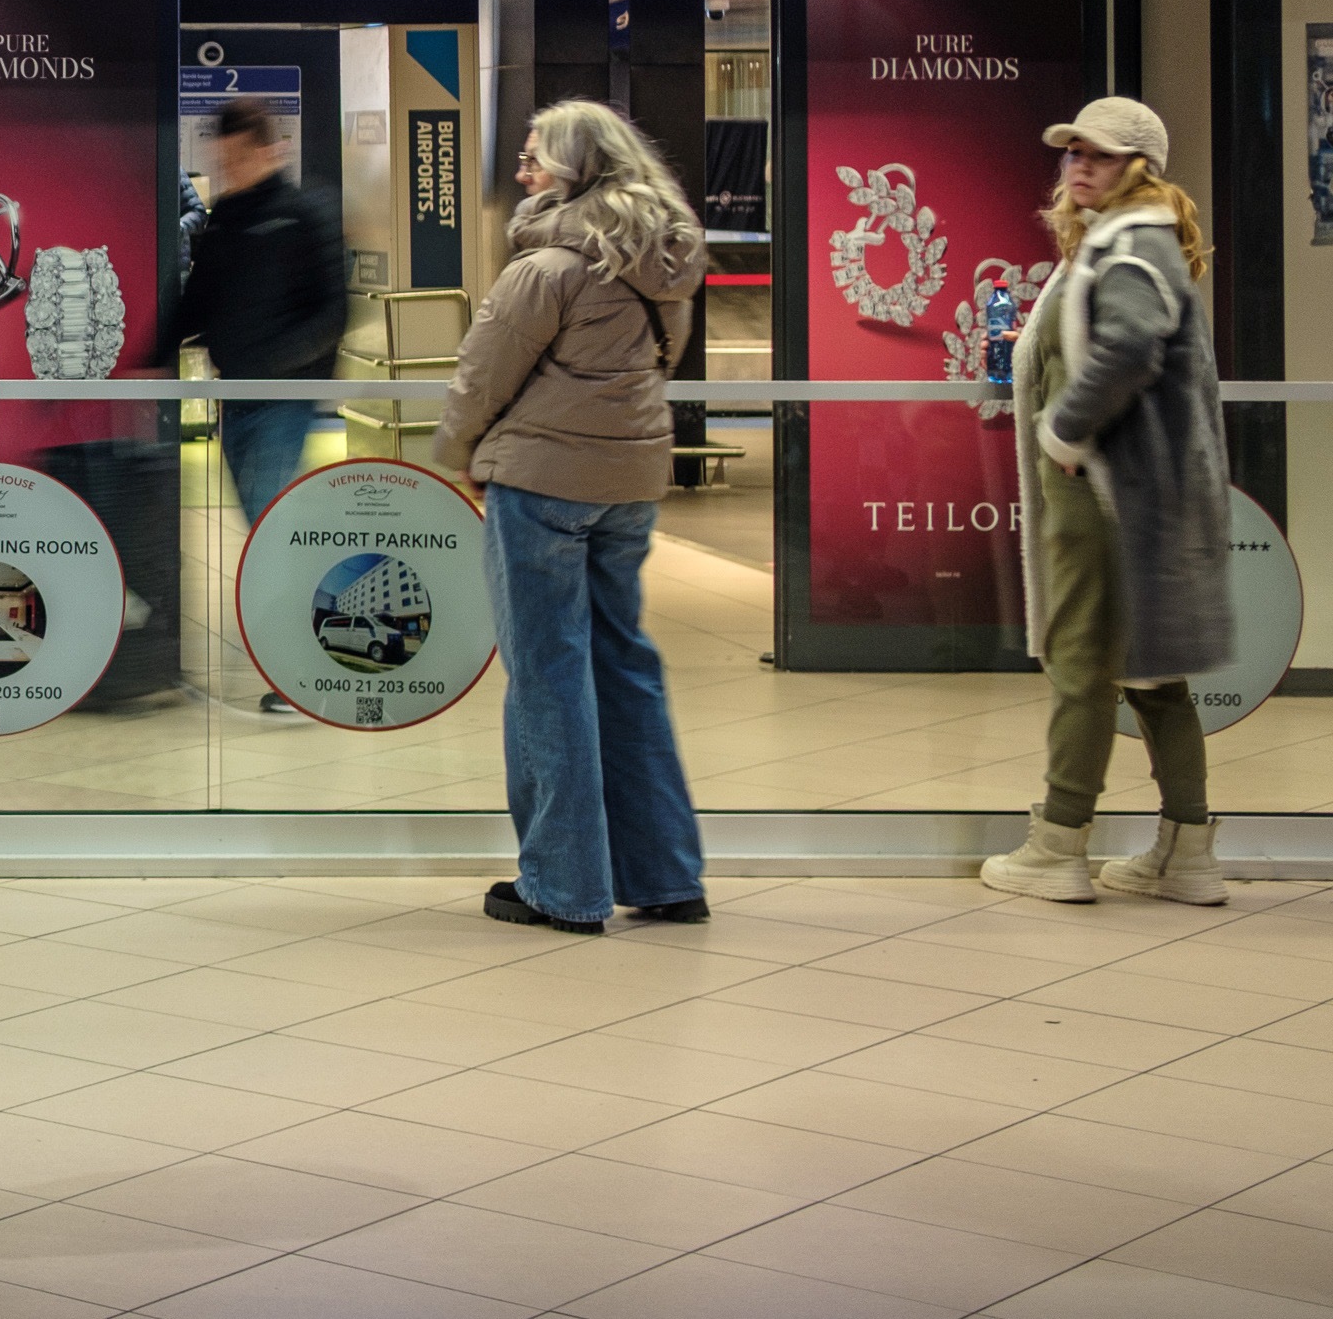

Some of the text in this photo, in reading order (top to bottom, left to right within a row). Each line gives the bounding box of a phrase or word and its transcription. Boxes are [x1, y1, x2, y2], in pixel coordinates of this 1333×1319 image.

[915, 34, 974, 54] PURE
[870, 57, 1021, 82] DIAMONDS
[225, 69, 239, 92] 2
[437, 120, 456, 230] BUCHAREST
[328, 473, 420, 490] VIENNA HOUSE
[863, 501, 1023, 532] TEILOR
[36, 540, 99, 556] ROOMS
[289, 531, 458, 550] AIRPORT PARKING
[25, 686, 63, 701] 6500
[314, 679, 446, 695] 0040 21 203 6500
[1204, 693, 1243, 707] 6500
